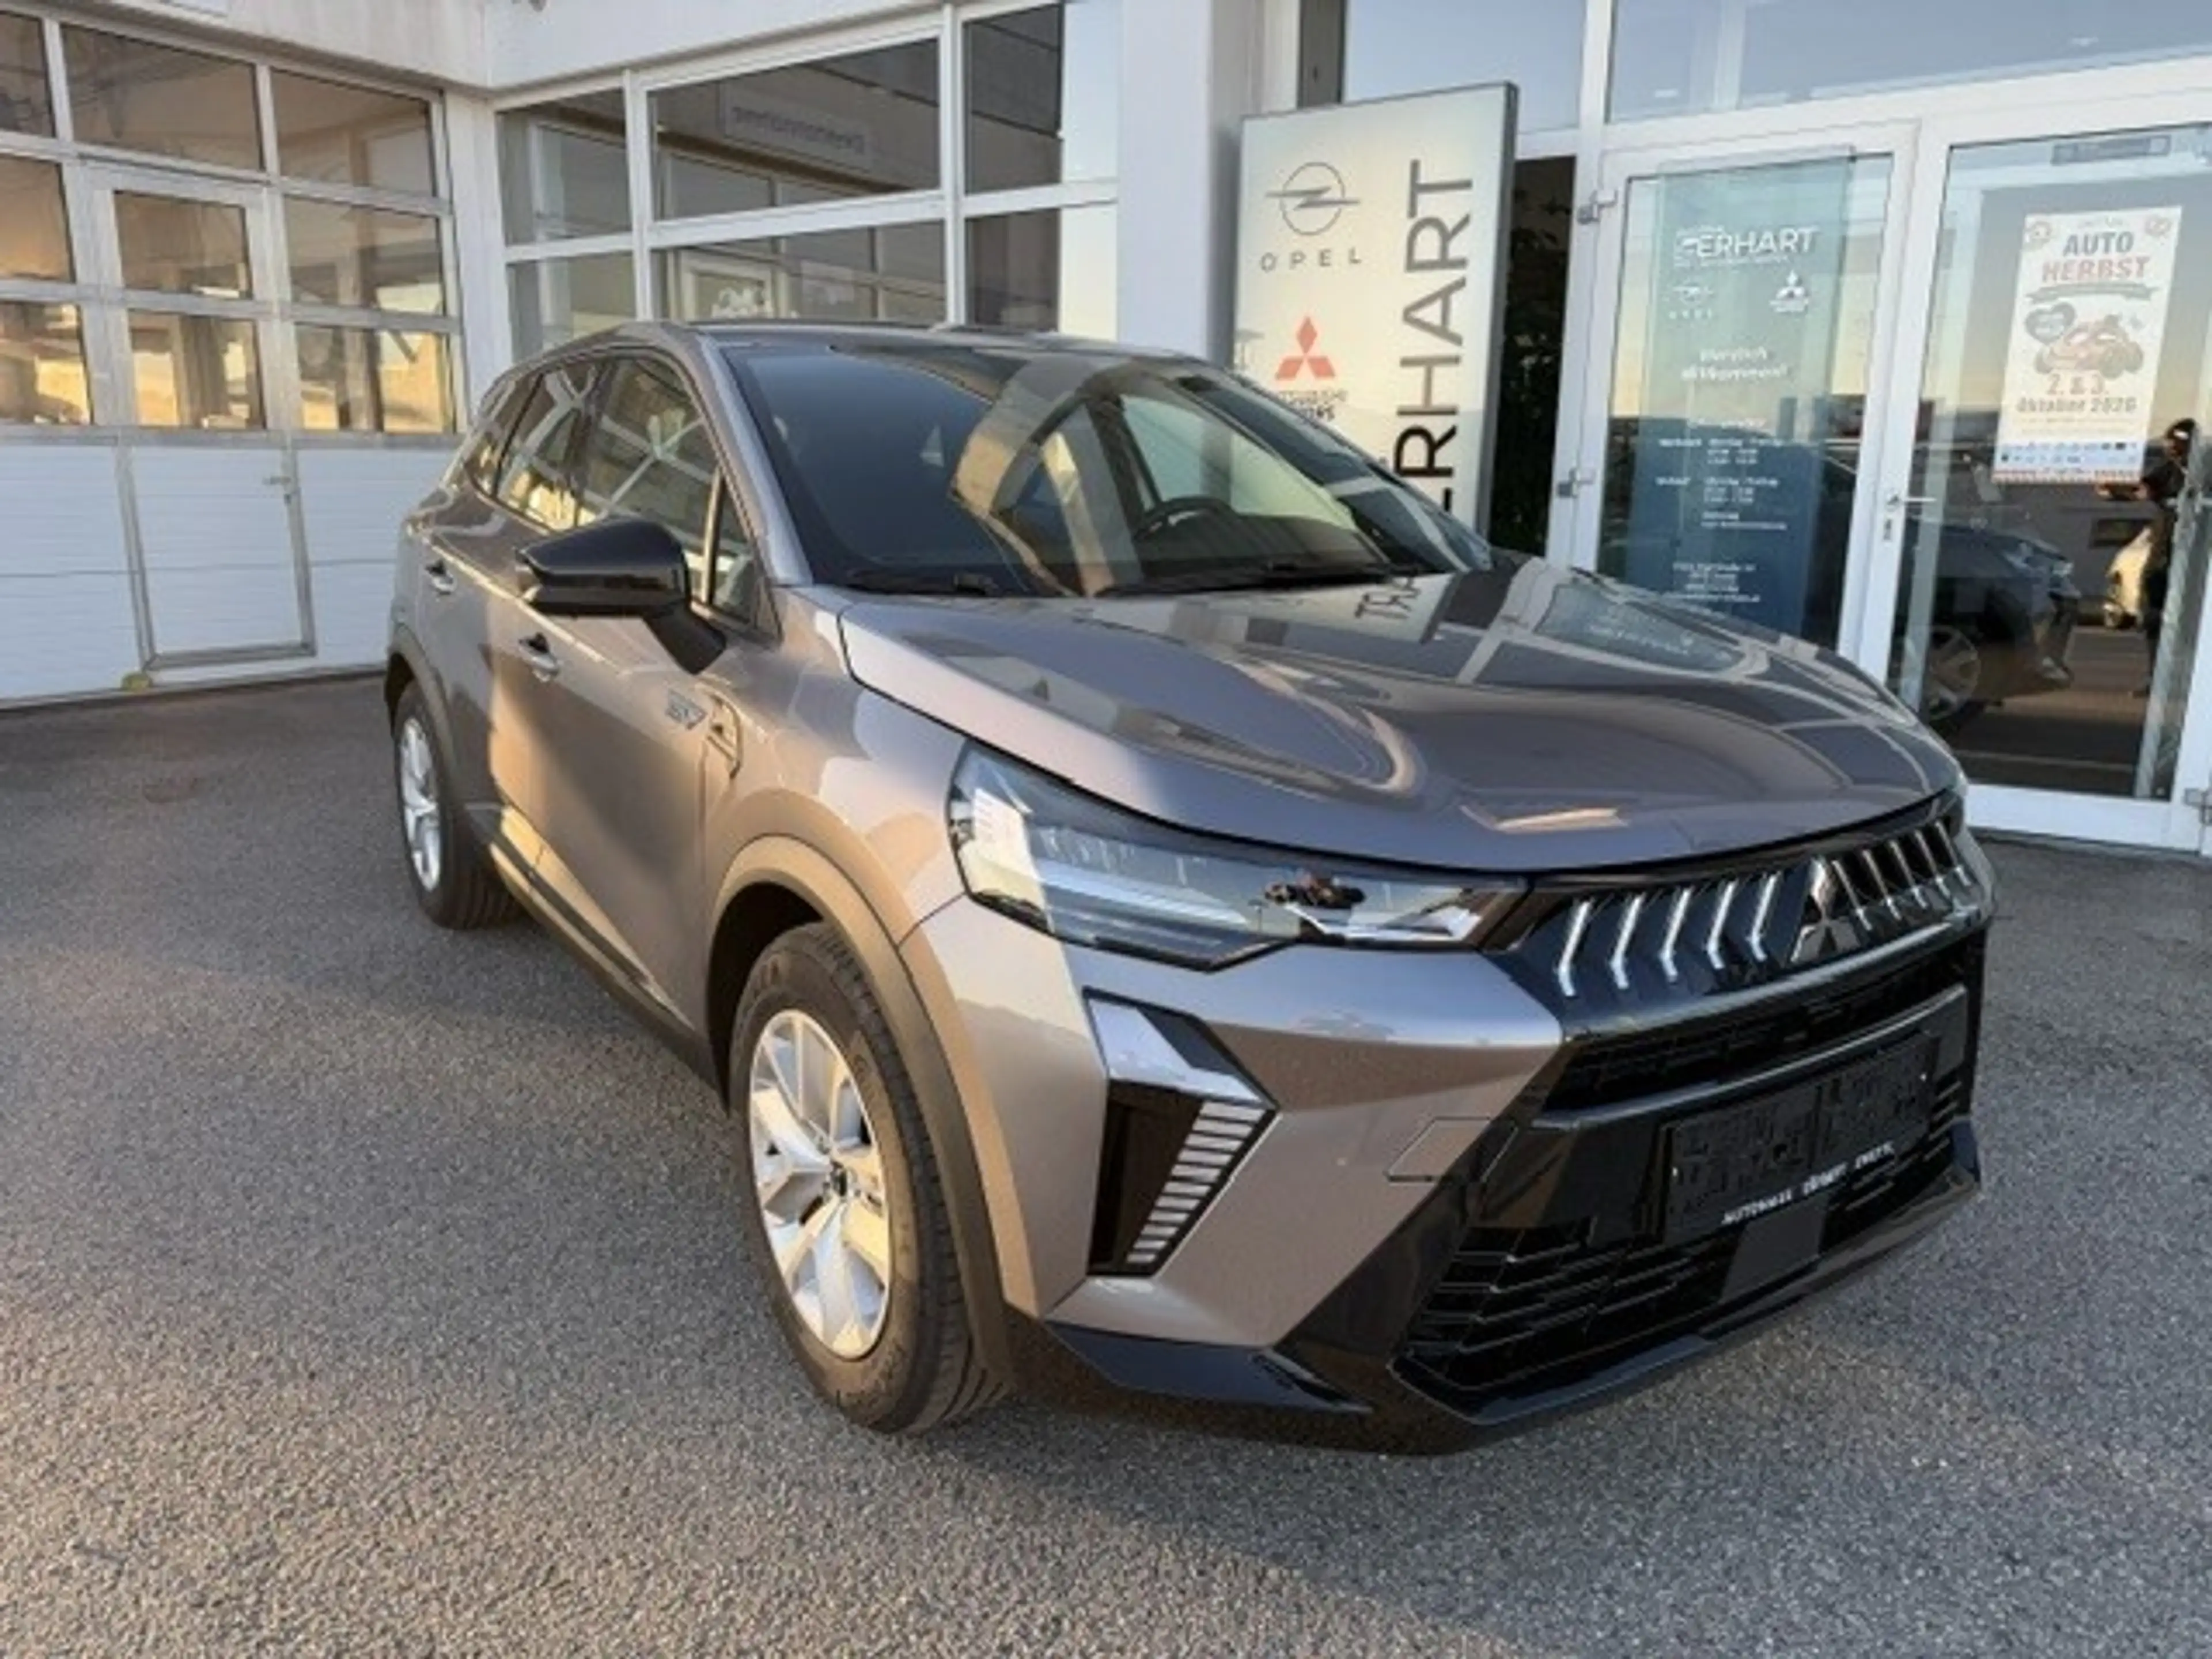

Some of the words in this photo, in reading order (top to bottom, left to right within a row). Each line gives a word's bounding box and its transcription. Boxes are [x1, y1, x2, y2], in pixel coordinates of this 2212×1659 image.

[1696, 227, 1818, 258] ERHART
[2062, 232, 2135, 256] AUTO
[1260, 248, 1362, 272] OPEL
[2041, 256, 2150, 283] HERBST
